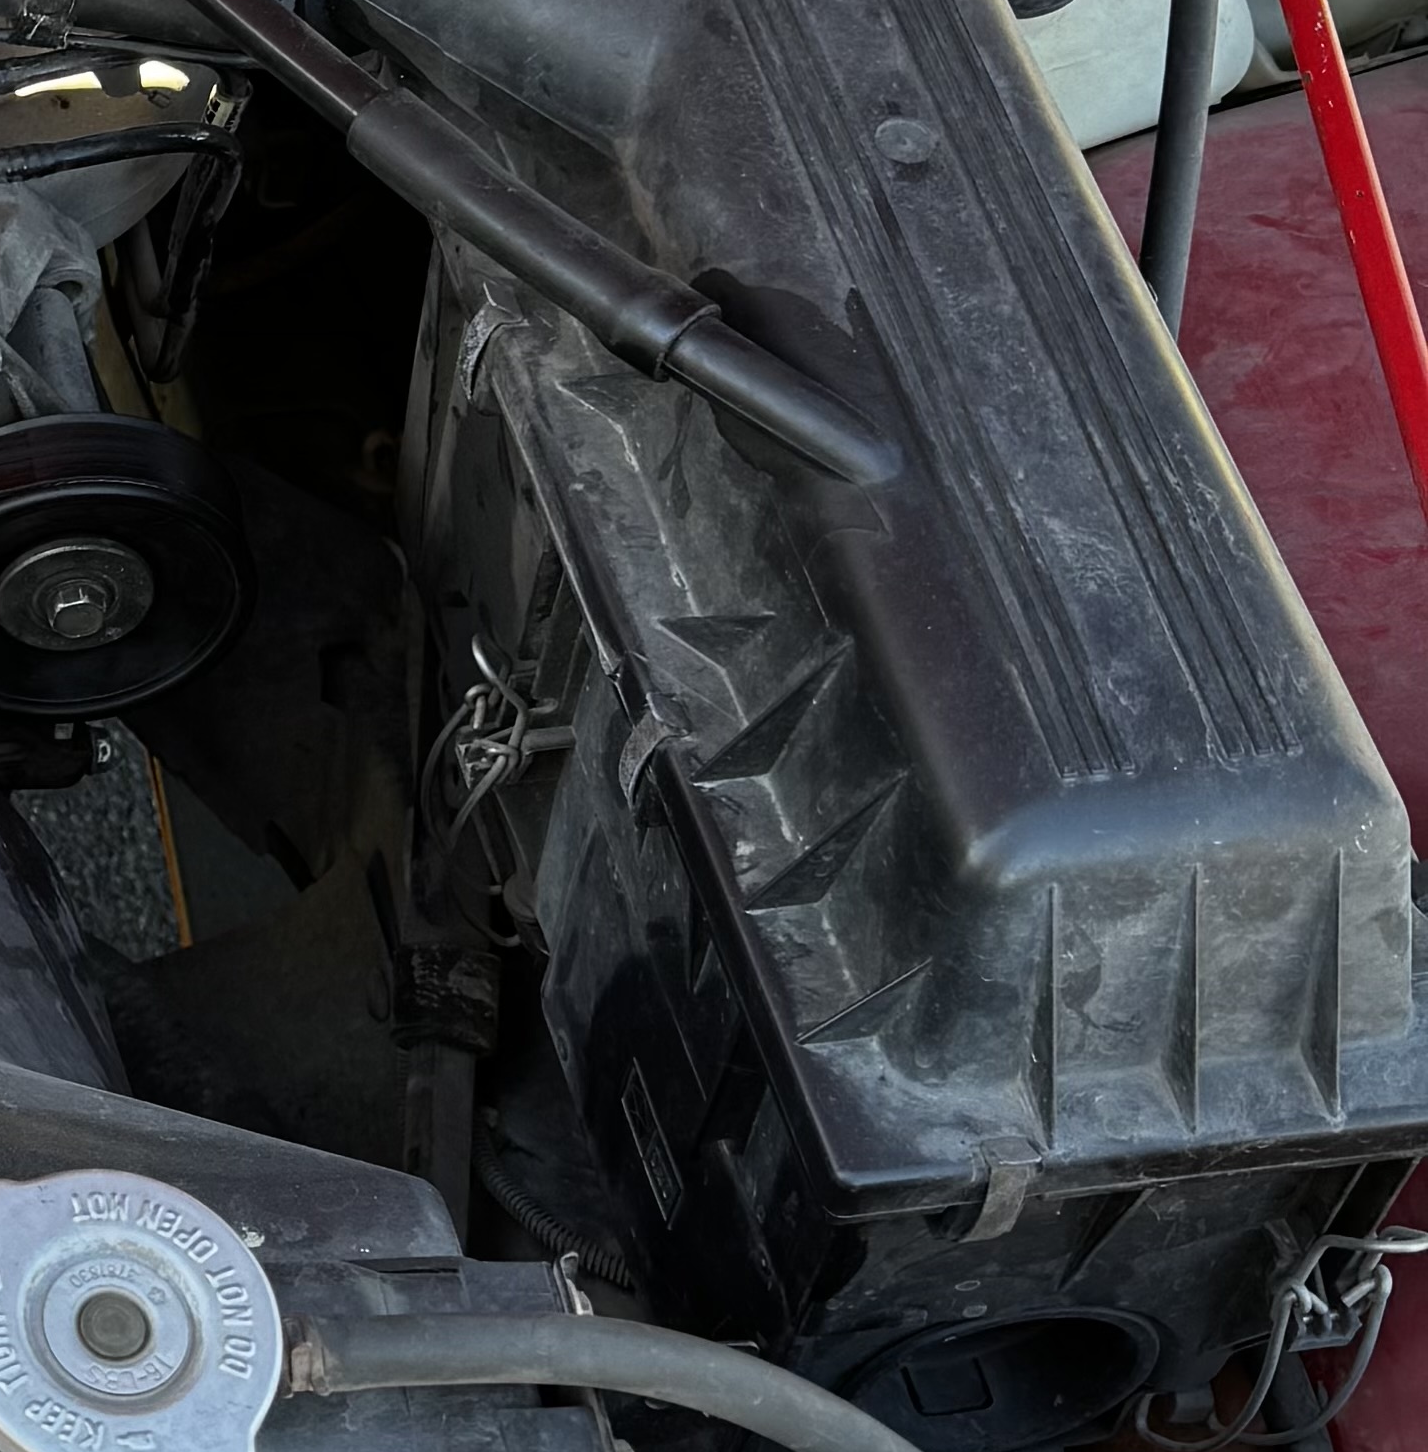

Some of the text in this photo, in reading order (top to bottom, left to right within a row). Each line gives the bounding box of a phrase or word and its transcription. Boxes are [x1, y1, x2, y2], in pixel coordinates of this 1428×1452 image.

[70, 1191, 257, 1379] DO NOT OPEN HOT
[24, 1397, 105, 1450] KEEP
